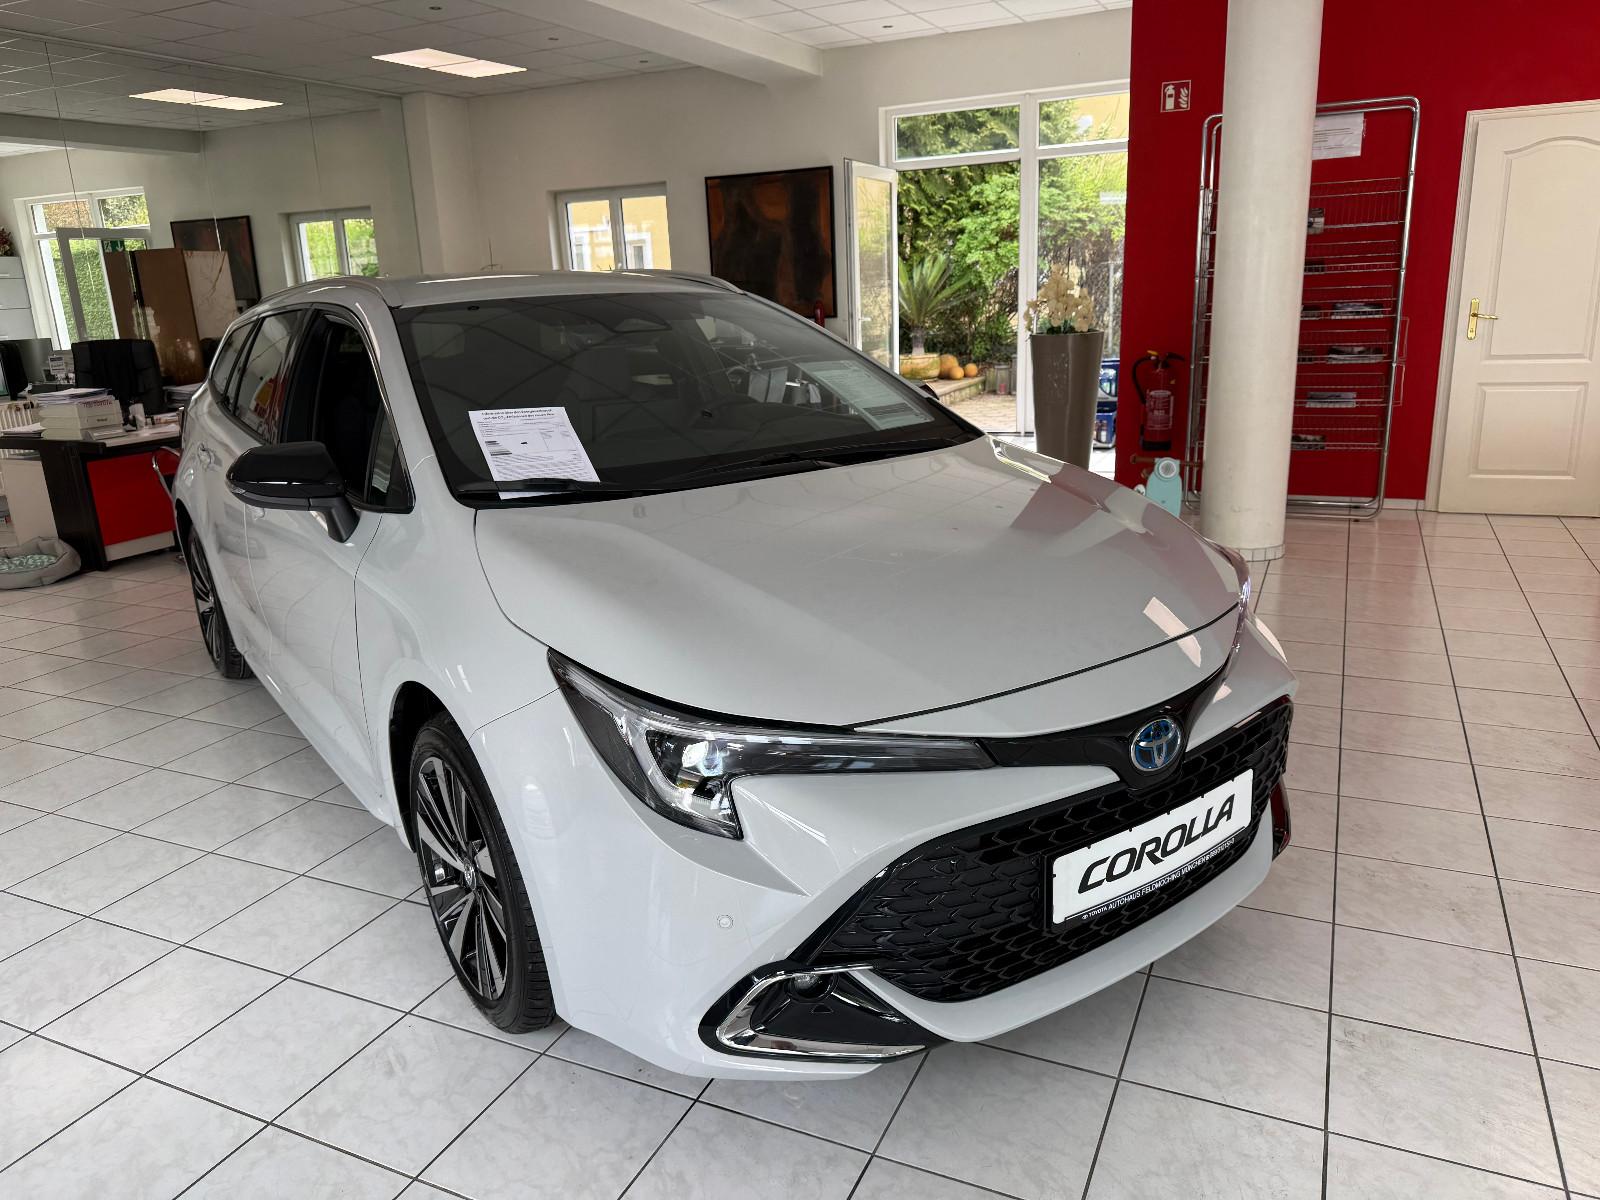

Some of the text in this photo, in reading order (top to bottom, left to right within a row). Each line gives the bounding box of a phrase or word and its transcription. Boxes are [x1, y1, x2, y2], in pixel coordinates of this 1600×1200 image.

[1078, 793, 1235, 894] COROLLA
[1089, 906, 1108, 918] TOYOTA
[1108, 890, 1141, 910] AUTOHAUS
[1141, 870, 1181, 896] FELDMOCHING
